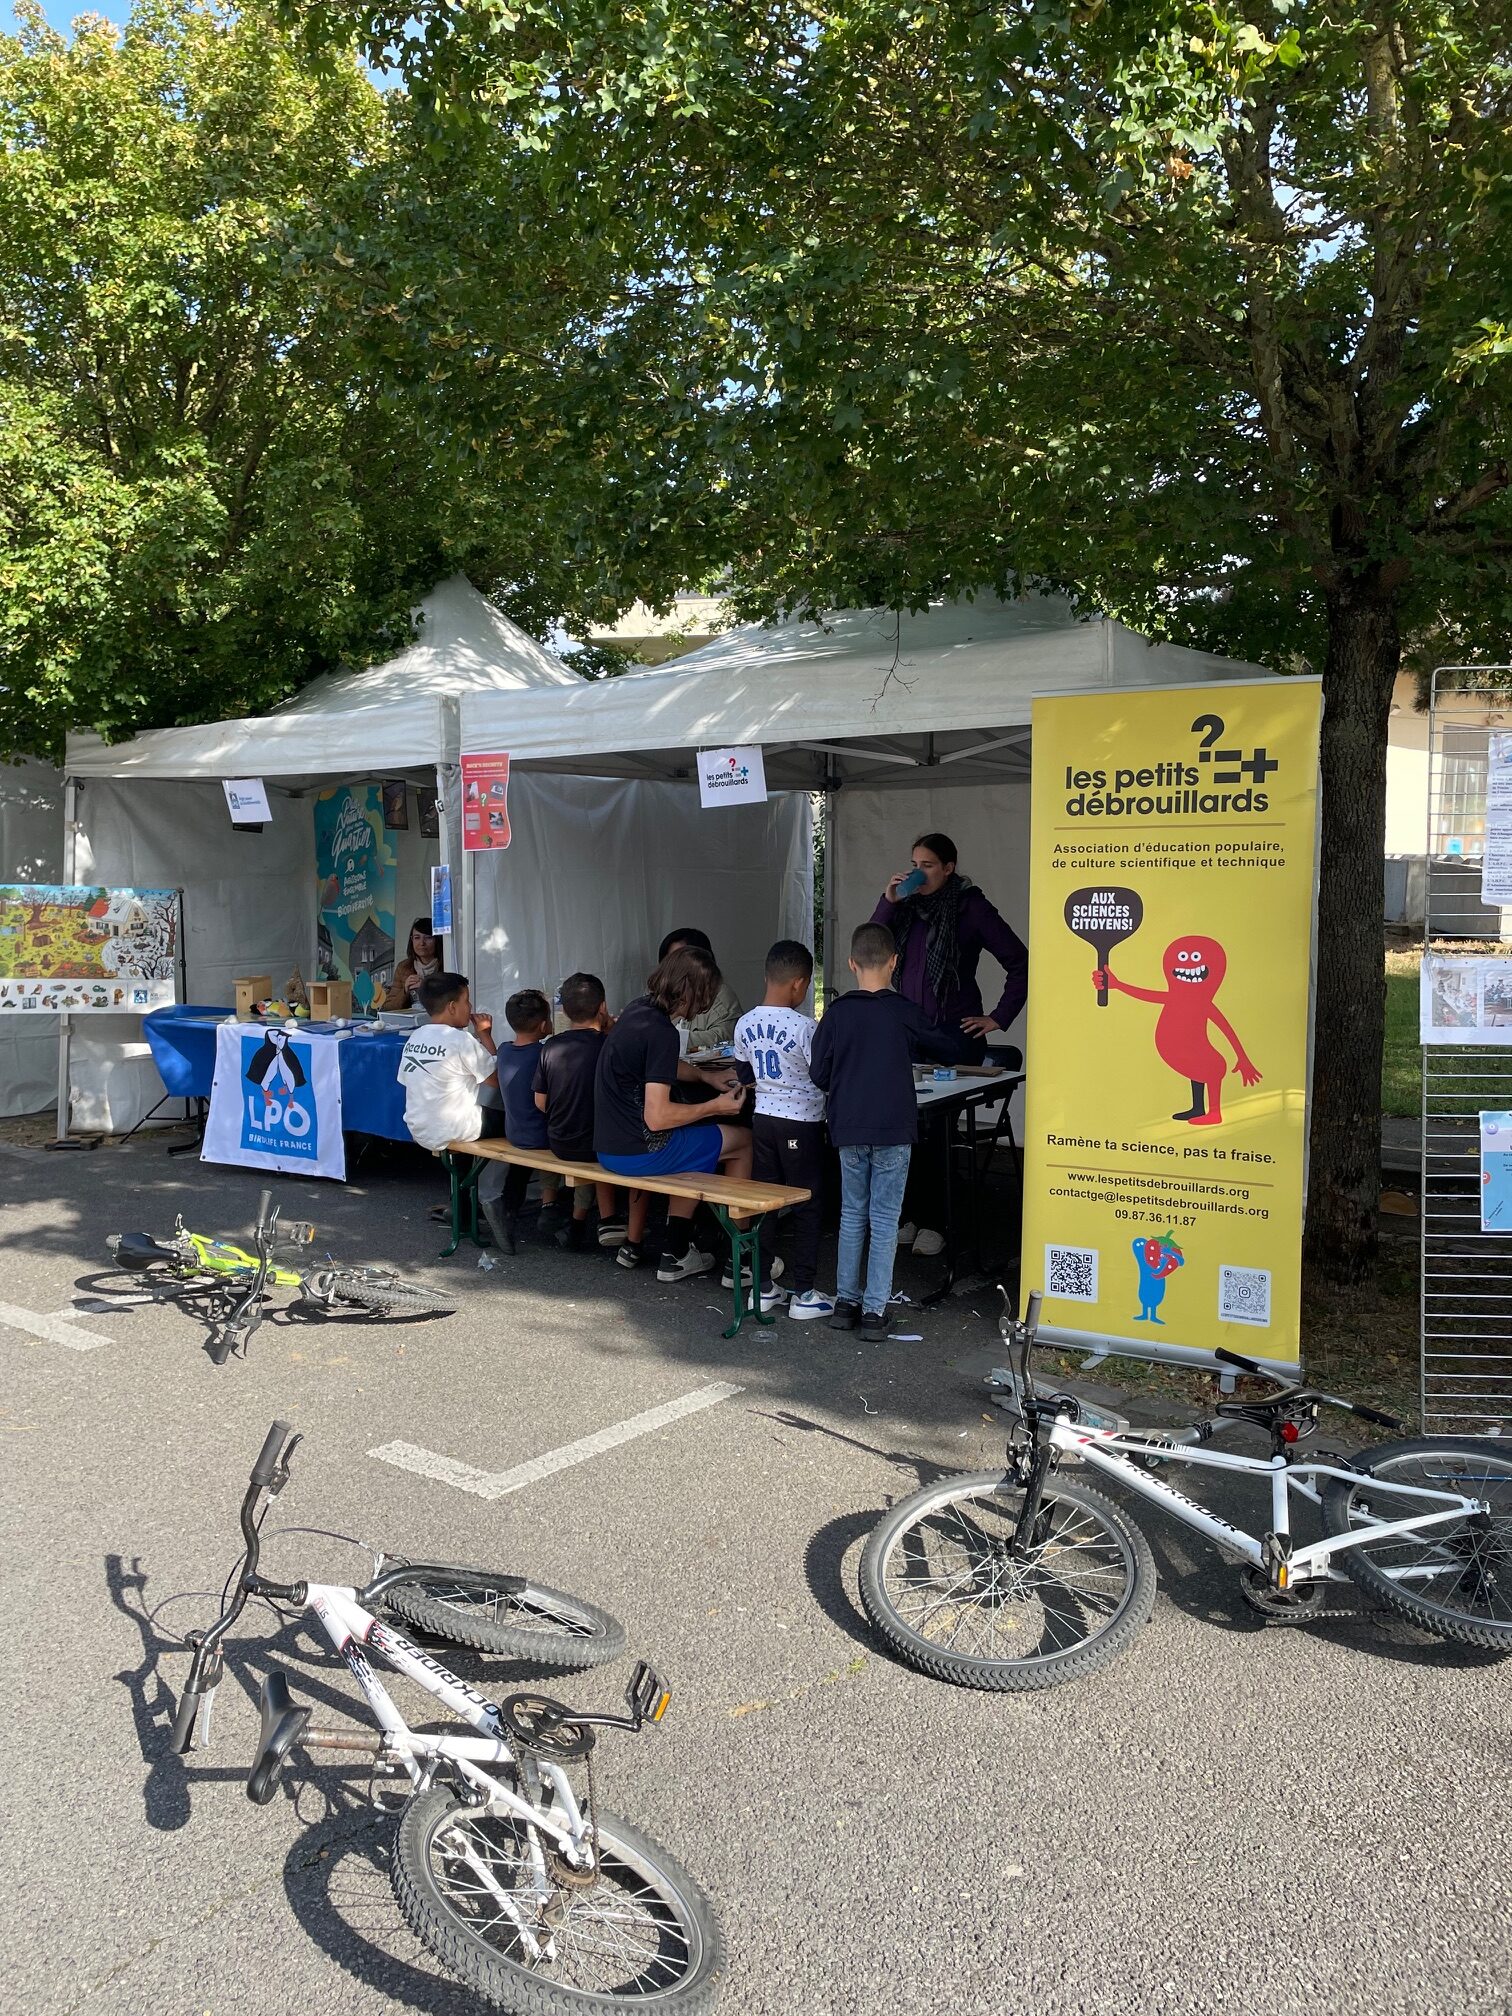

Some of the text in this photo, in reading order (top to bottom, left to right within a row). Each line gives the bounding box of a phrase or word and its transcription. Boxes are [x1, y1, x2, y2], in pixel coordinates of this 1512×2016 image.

[716, 772, 733, 780] petits
[1065, 762, 1199, 793] les petits
[1065, 788, 1268, 816] débrouillards
[1054, 841, 1284, 854] Association d'éducation populaire,
[1052, 856, 1286, 870] de culture scientifique et technique
[1091, 892, 1116, 904] AUX
[1072, 905, 1130, 918] SCIENCES
[1071, 918, 1133, 930] CITOYENS!
[404, 1042, 446, 1056] Reebok
[742, 1023, 796, 1053] FRANCE
[754, 1050, 782, 1080] 10
[248, 1096, 310, 1136] LPO
[248, 1134, 312, 1150] BIRDLIFE FRANCE
[1046, 1134, 1276, 1164] Ramène ta science, pas ta fraise.
[1068, 1172, 1250, 1200] www.lespetitsdebrouillards.org
[1049, 1186, 1269, 1220] contactge@lespetitsdebrouillards.org
[1115, 1209, 1196, 1226] 09.87.36.11.87
[396, 1639, 503, 1716] OCKRIDER
